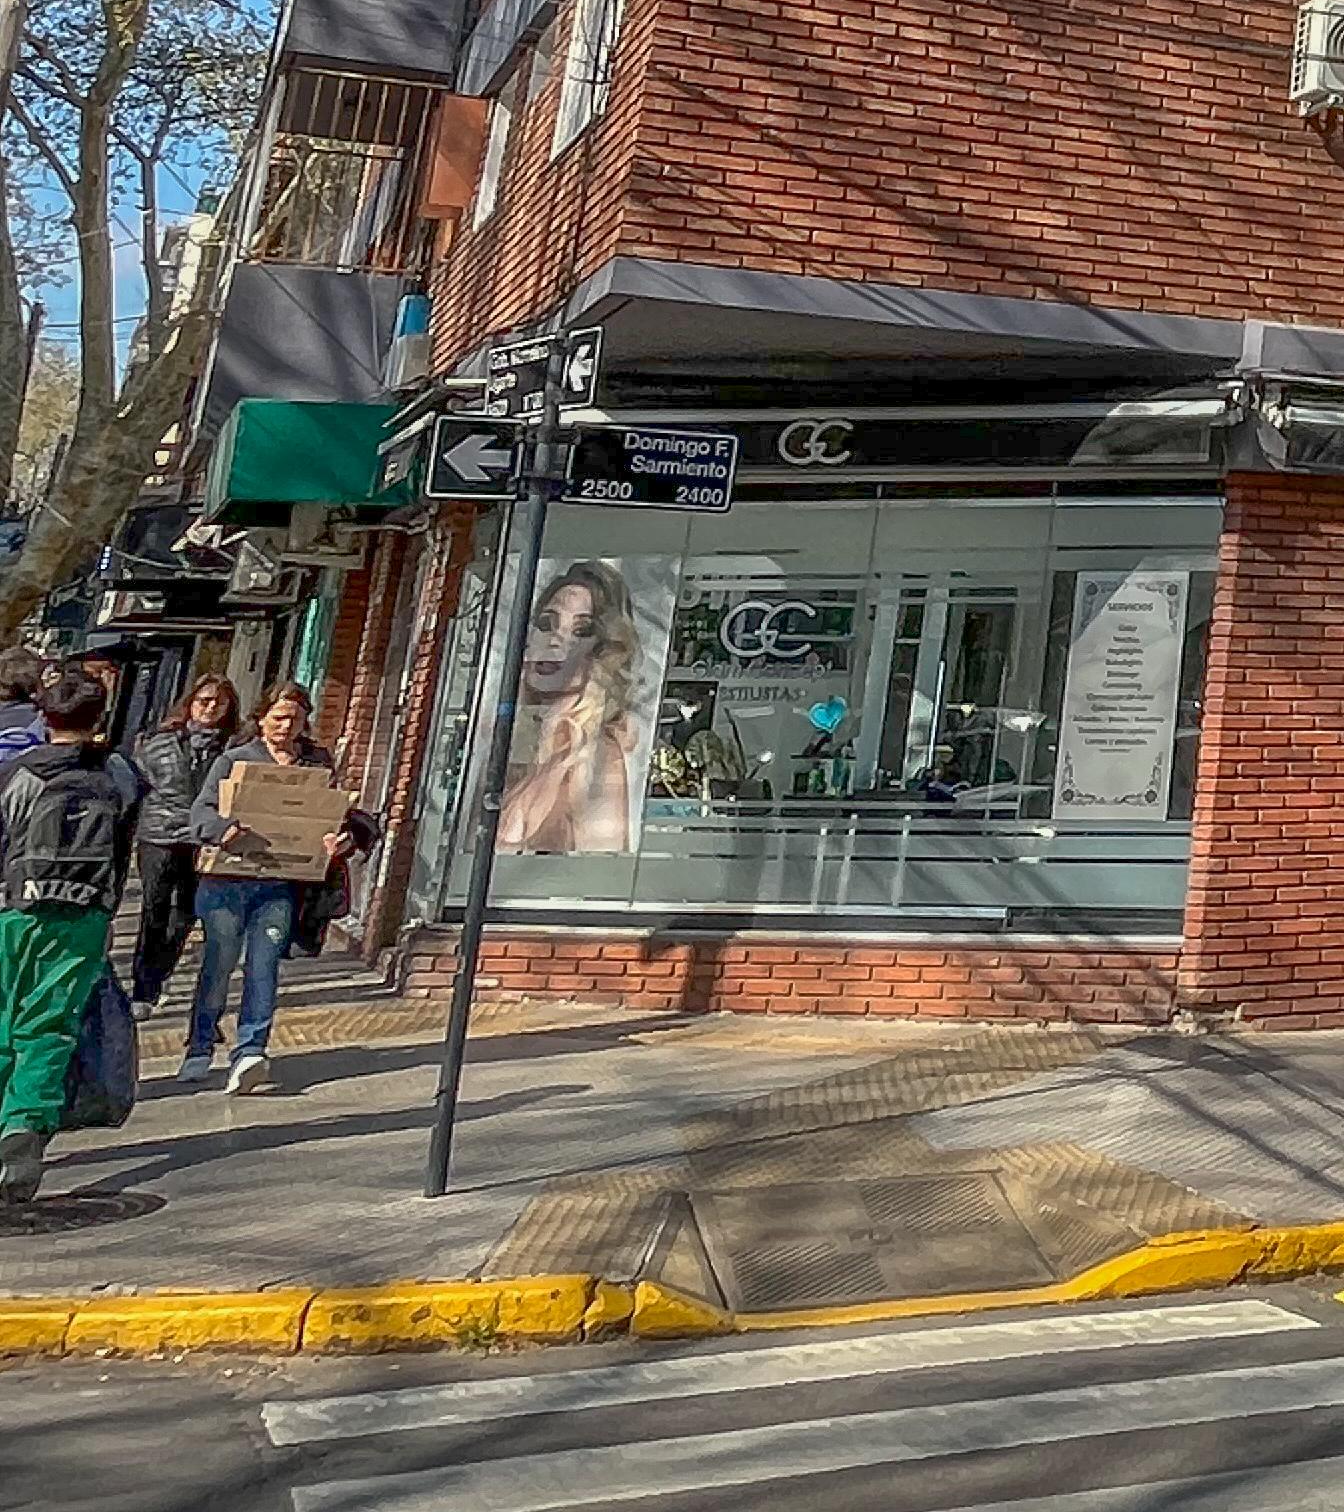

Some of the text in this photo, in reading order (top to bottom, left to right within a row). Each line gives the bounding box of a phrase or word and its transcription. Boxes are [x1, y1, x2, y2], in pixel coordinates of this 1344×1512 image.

[624, 433, 729, 457] Domingo F.
[631, 454, 727, 478] Sarmiento
[580, 479, 723, 505] 2500 2400
[23, 879, 98, 904] NIKE
